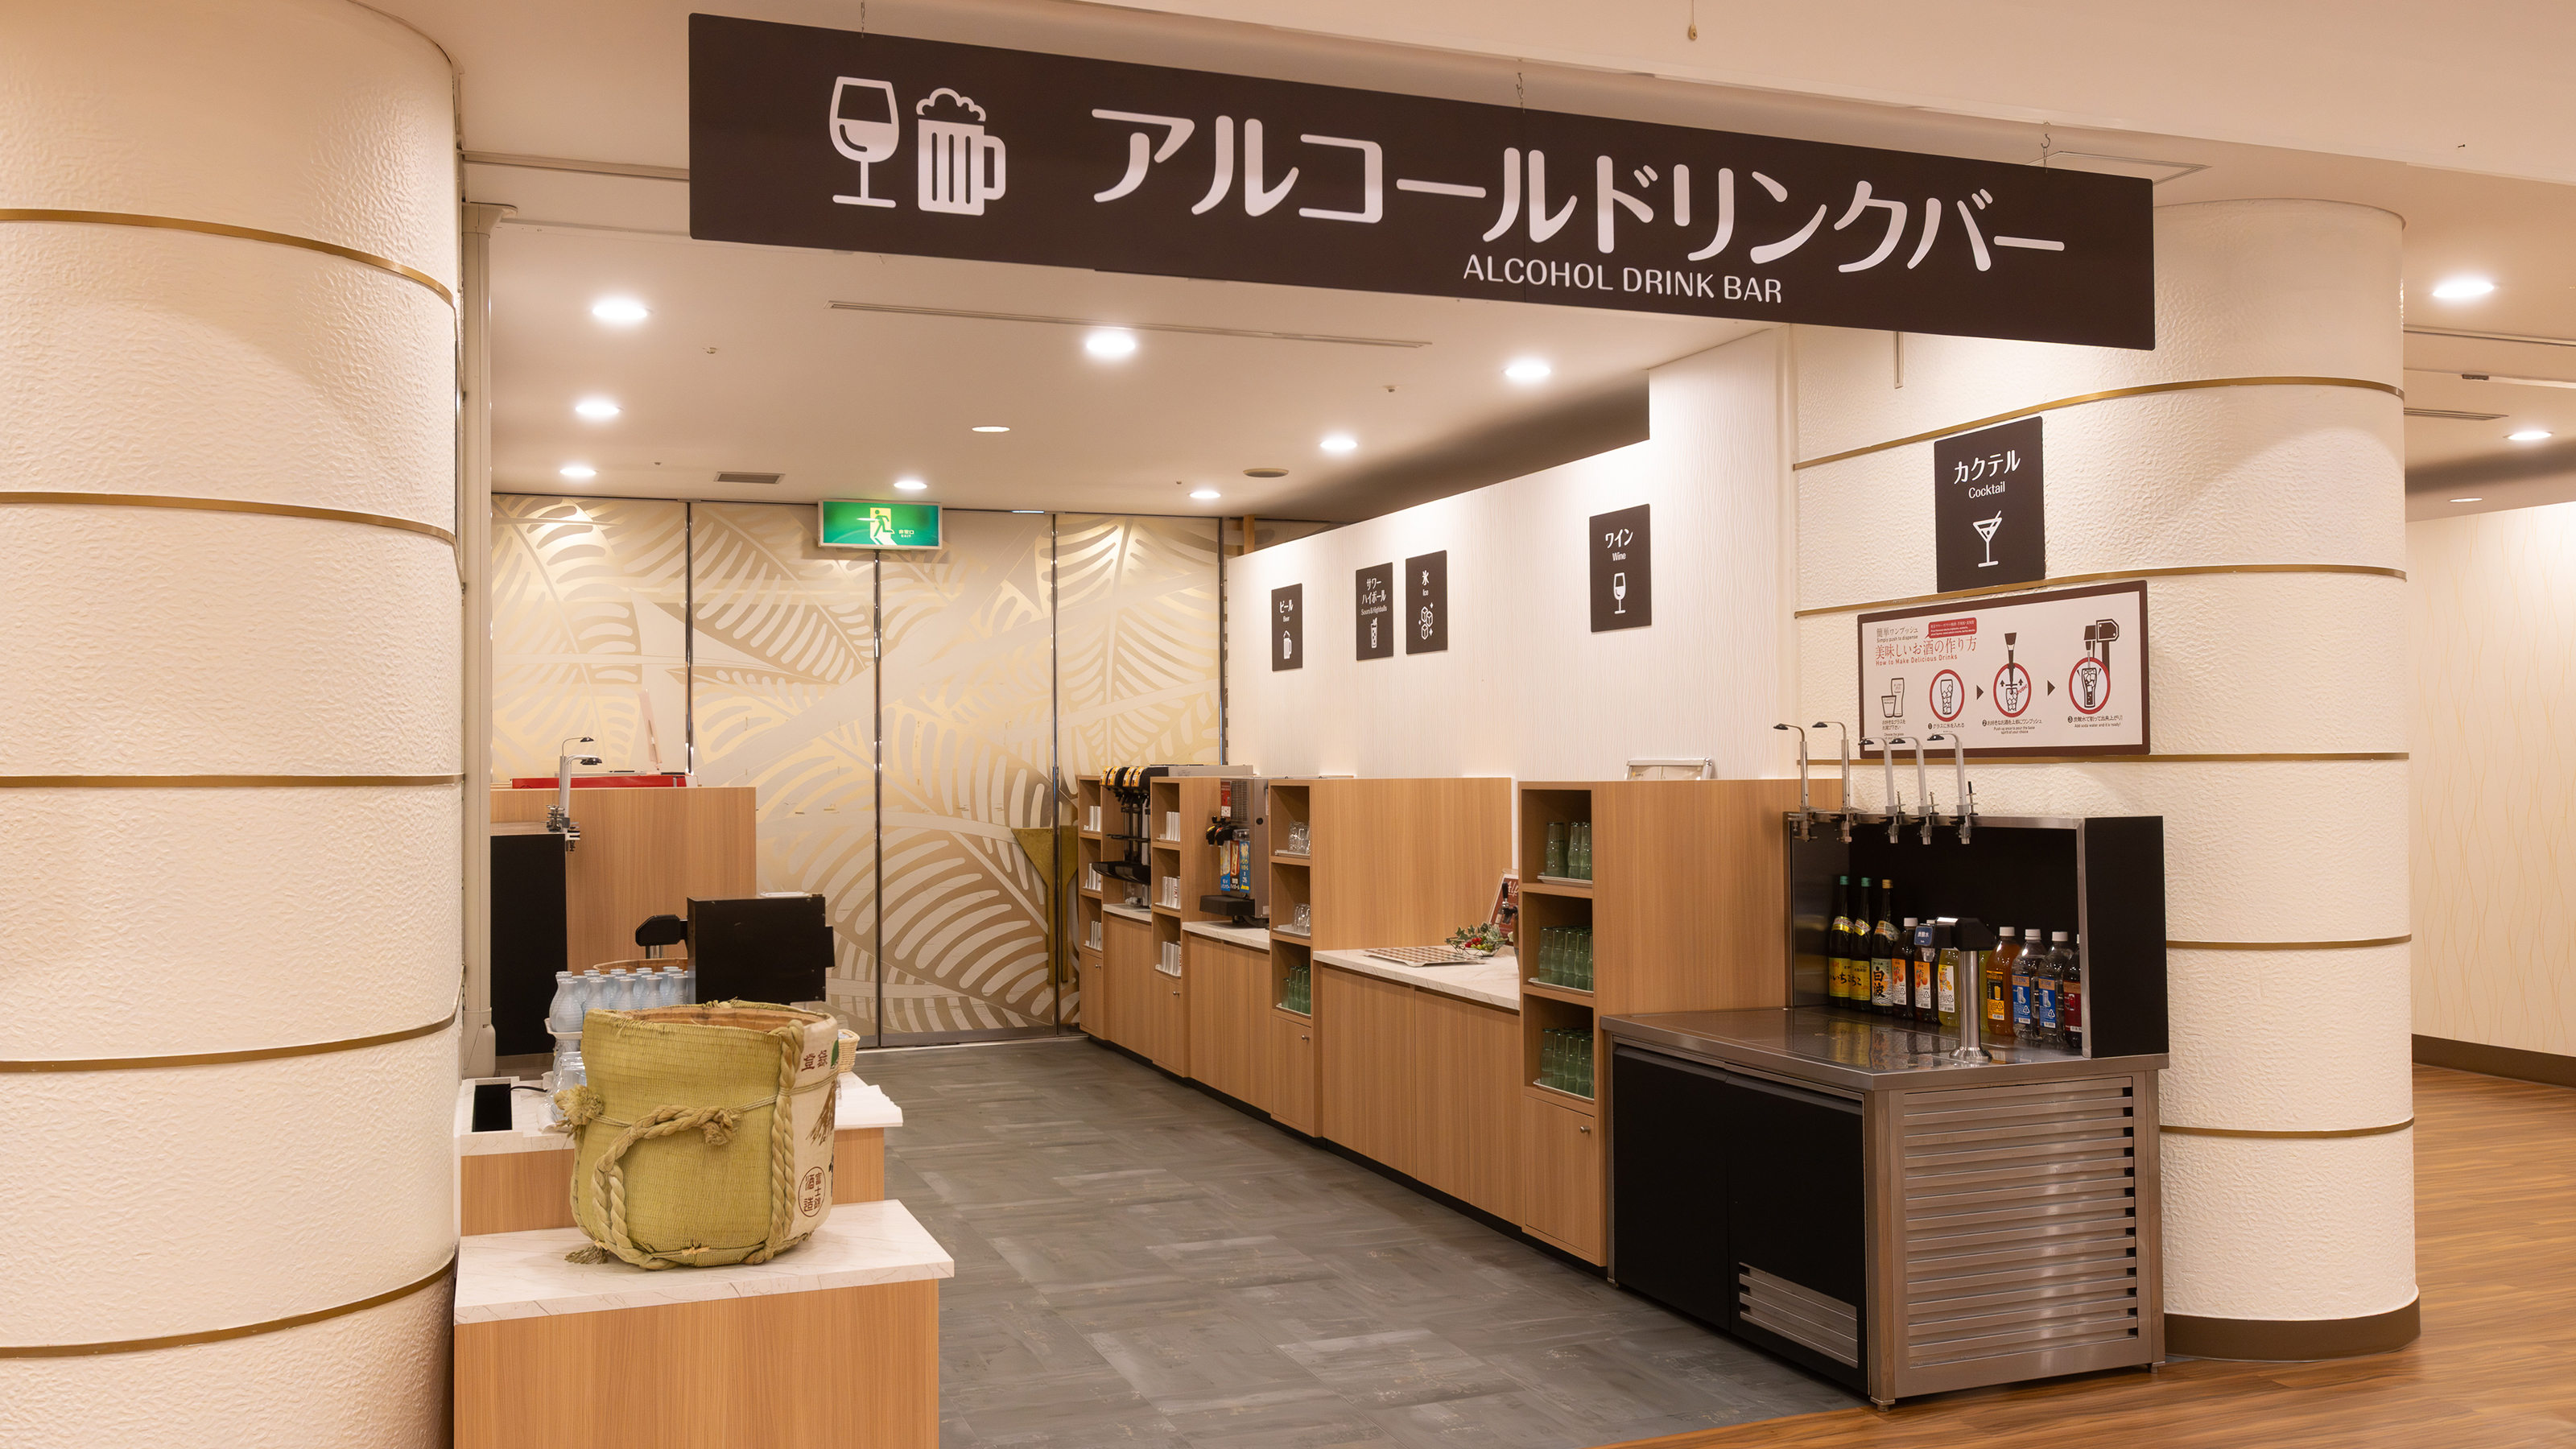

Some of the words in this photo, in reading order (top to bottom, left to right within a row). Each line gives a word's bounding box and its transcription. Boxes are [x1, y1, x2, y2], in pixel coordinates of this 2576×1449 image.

[1092, 109, 2065, 272] アルコールドリンクバー
[1463, 255, 1612, 291] ALCOHOL
[1622, 267, 1715, 299] DRINK
[1724, 275, 1781, 304] BAR
[1954, 449, 2021, 485] カクテル
[1968, 481, 2006, 499] Cocktail
[1605, 528, 1633, 548] ワイン
[1612, 551, 1626, 561] Wine
[1366, 577, 1381, 591] サワー
[1422, 570, 1429, 586] 氷
[1280, 599, 1294, 613] ビール
[1361, 589, 1386, 605] ハイボール
[1876, 636, 1977, 660] 美味しいお酒の作り方
[1873, 965, 1887, 997] 白波
